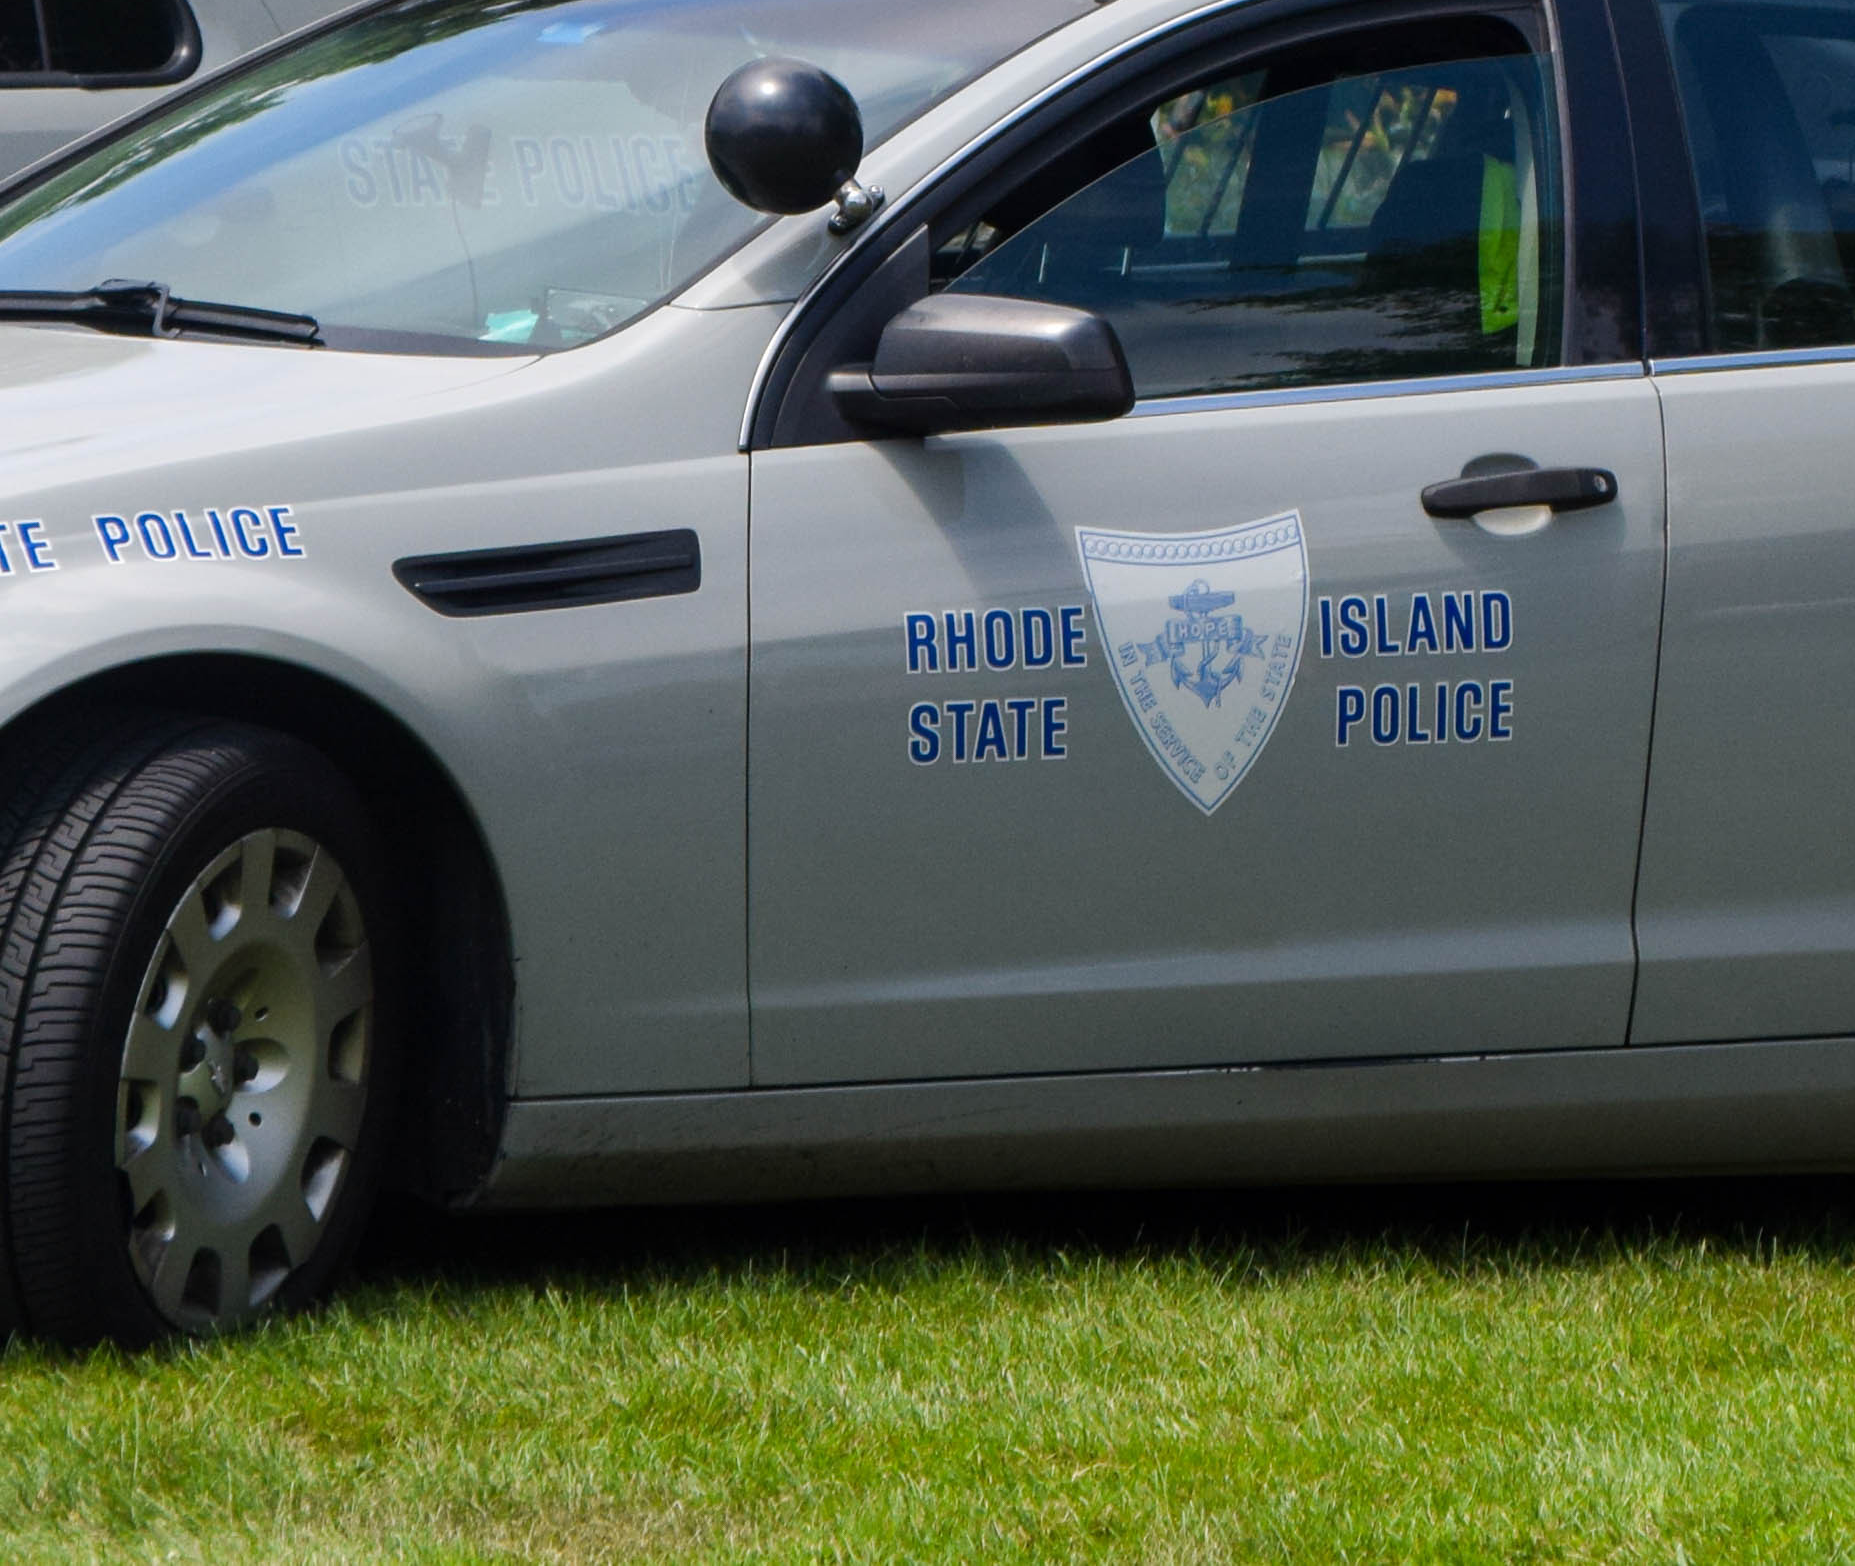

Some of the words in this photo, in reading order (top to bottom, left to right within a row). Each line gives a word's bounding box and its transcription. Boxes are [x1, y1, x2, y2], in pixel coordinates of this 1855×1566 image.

[513, 134, 698, 214] POLICE
[92, 505, 306, 564] POLICE
[904, 605, 1087, 673] RHODE
[1317, 589, 1513, 659] ISLAND
[1118, 641, 1138, 667] IN
[1178, 619, 1230, 636] HOPE
[907, 697, 1069, 766] STATE
[1335, 680, 1514, 747] POLICE
